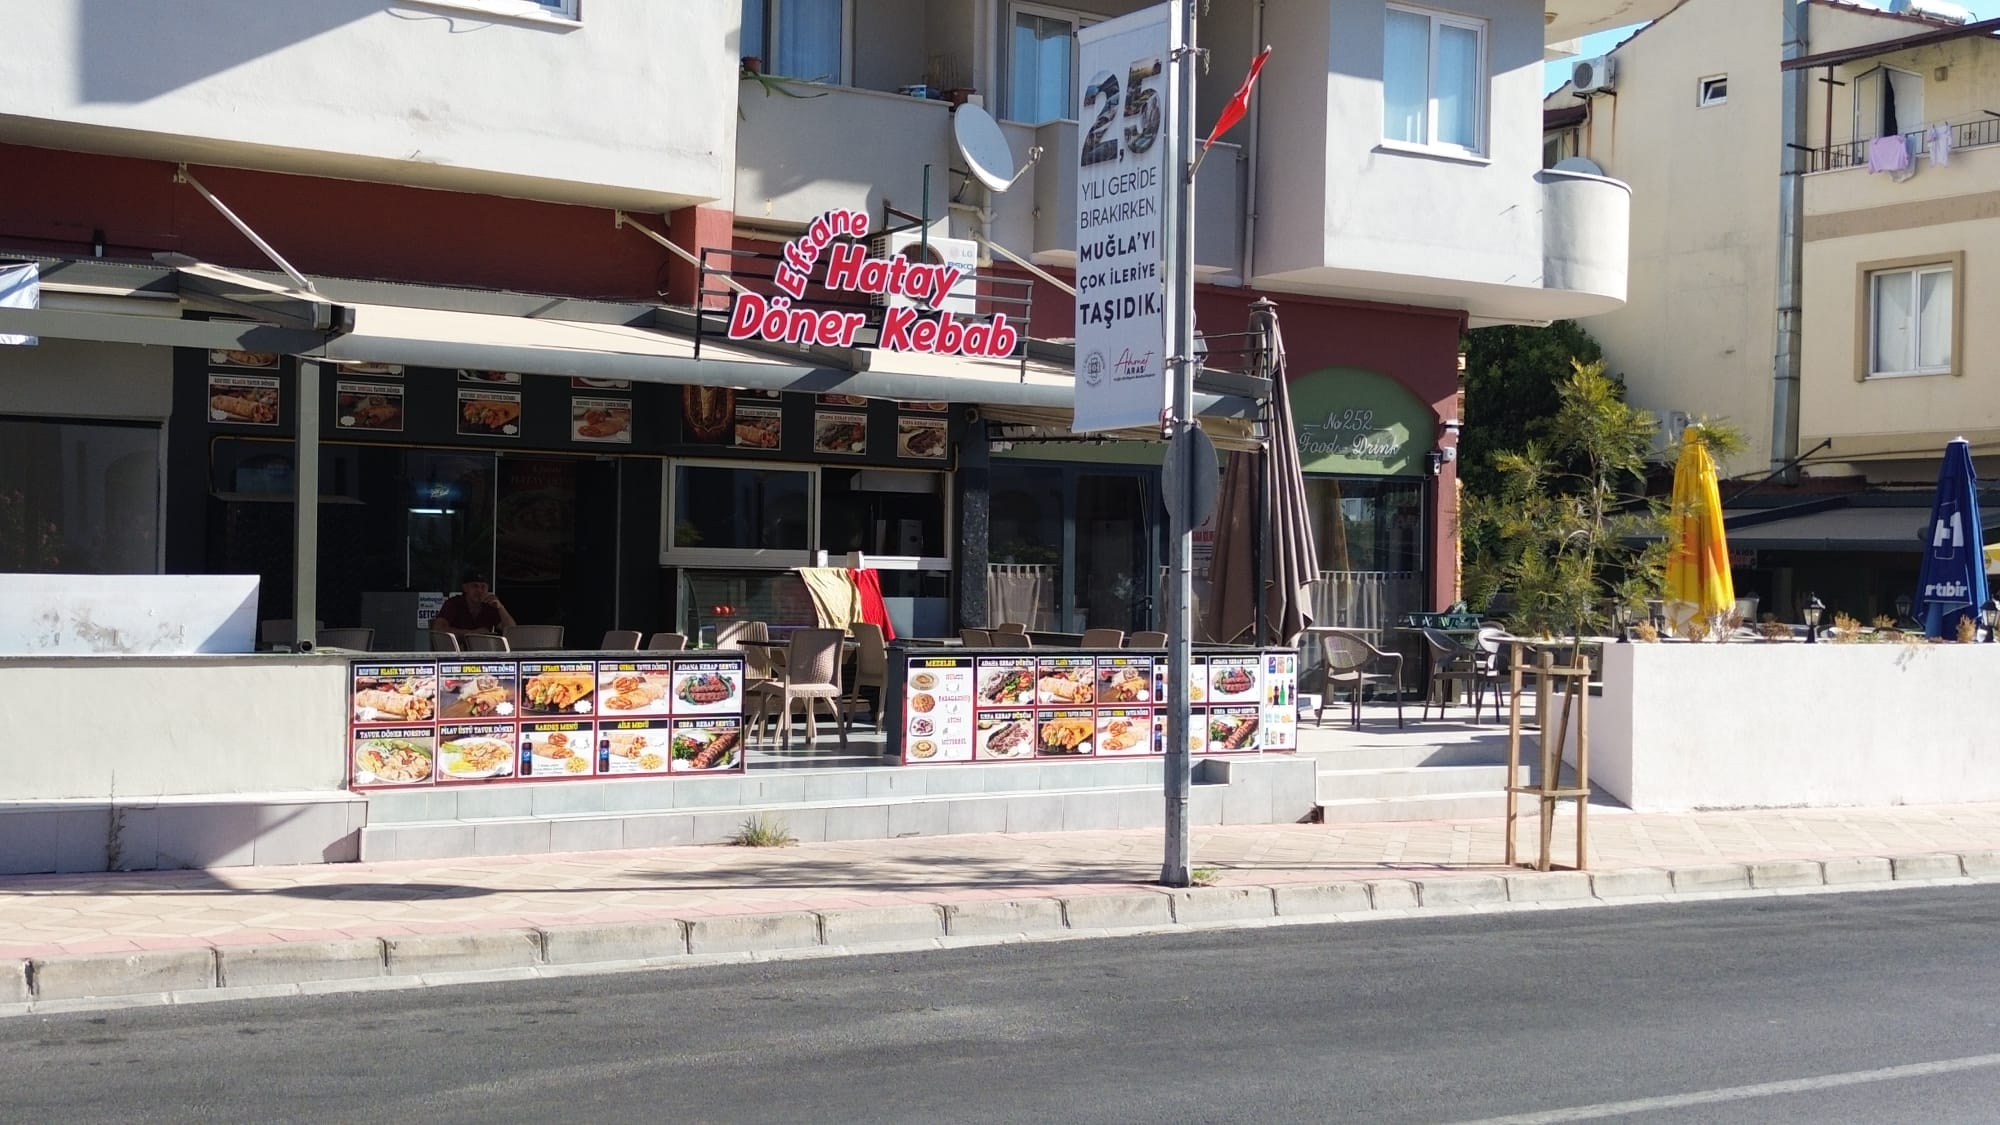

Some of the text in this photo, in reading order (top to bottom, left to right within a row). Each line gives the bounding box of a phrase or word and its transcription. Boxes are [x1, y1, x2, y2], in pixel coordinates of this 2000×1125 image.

[1080, 58, 1162, 168] 2,5
[1081, 166, 1157, 201] YILI GERİDE
[1080, 196, 1157, 229] BIRAKIRKEN,
[774, 207, 869, 299] Efsane
[1080, 230, 1156, 263] MUĞLA'YI
[826, 243, 961, 308] Hatay
[1080, 262, 1156, 294] ÇOK İLERİYE
[728, 291, 1018, 358] Döner Kebab
[1079, 291, 1161, 329] TAŞIDIK.
[1342, 408, 1374, 431] 252
[1352, 433, 1400, 455] Drink
